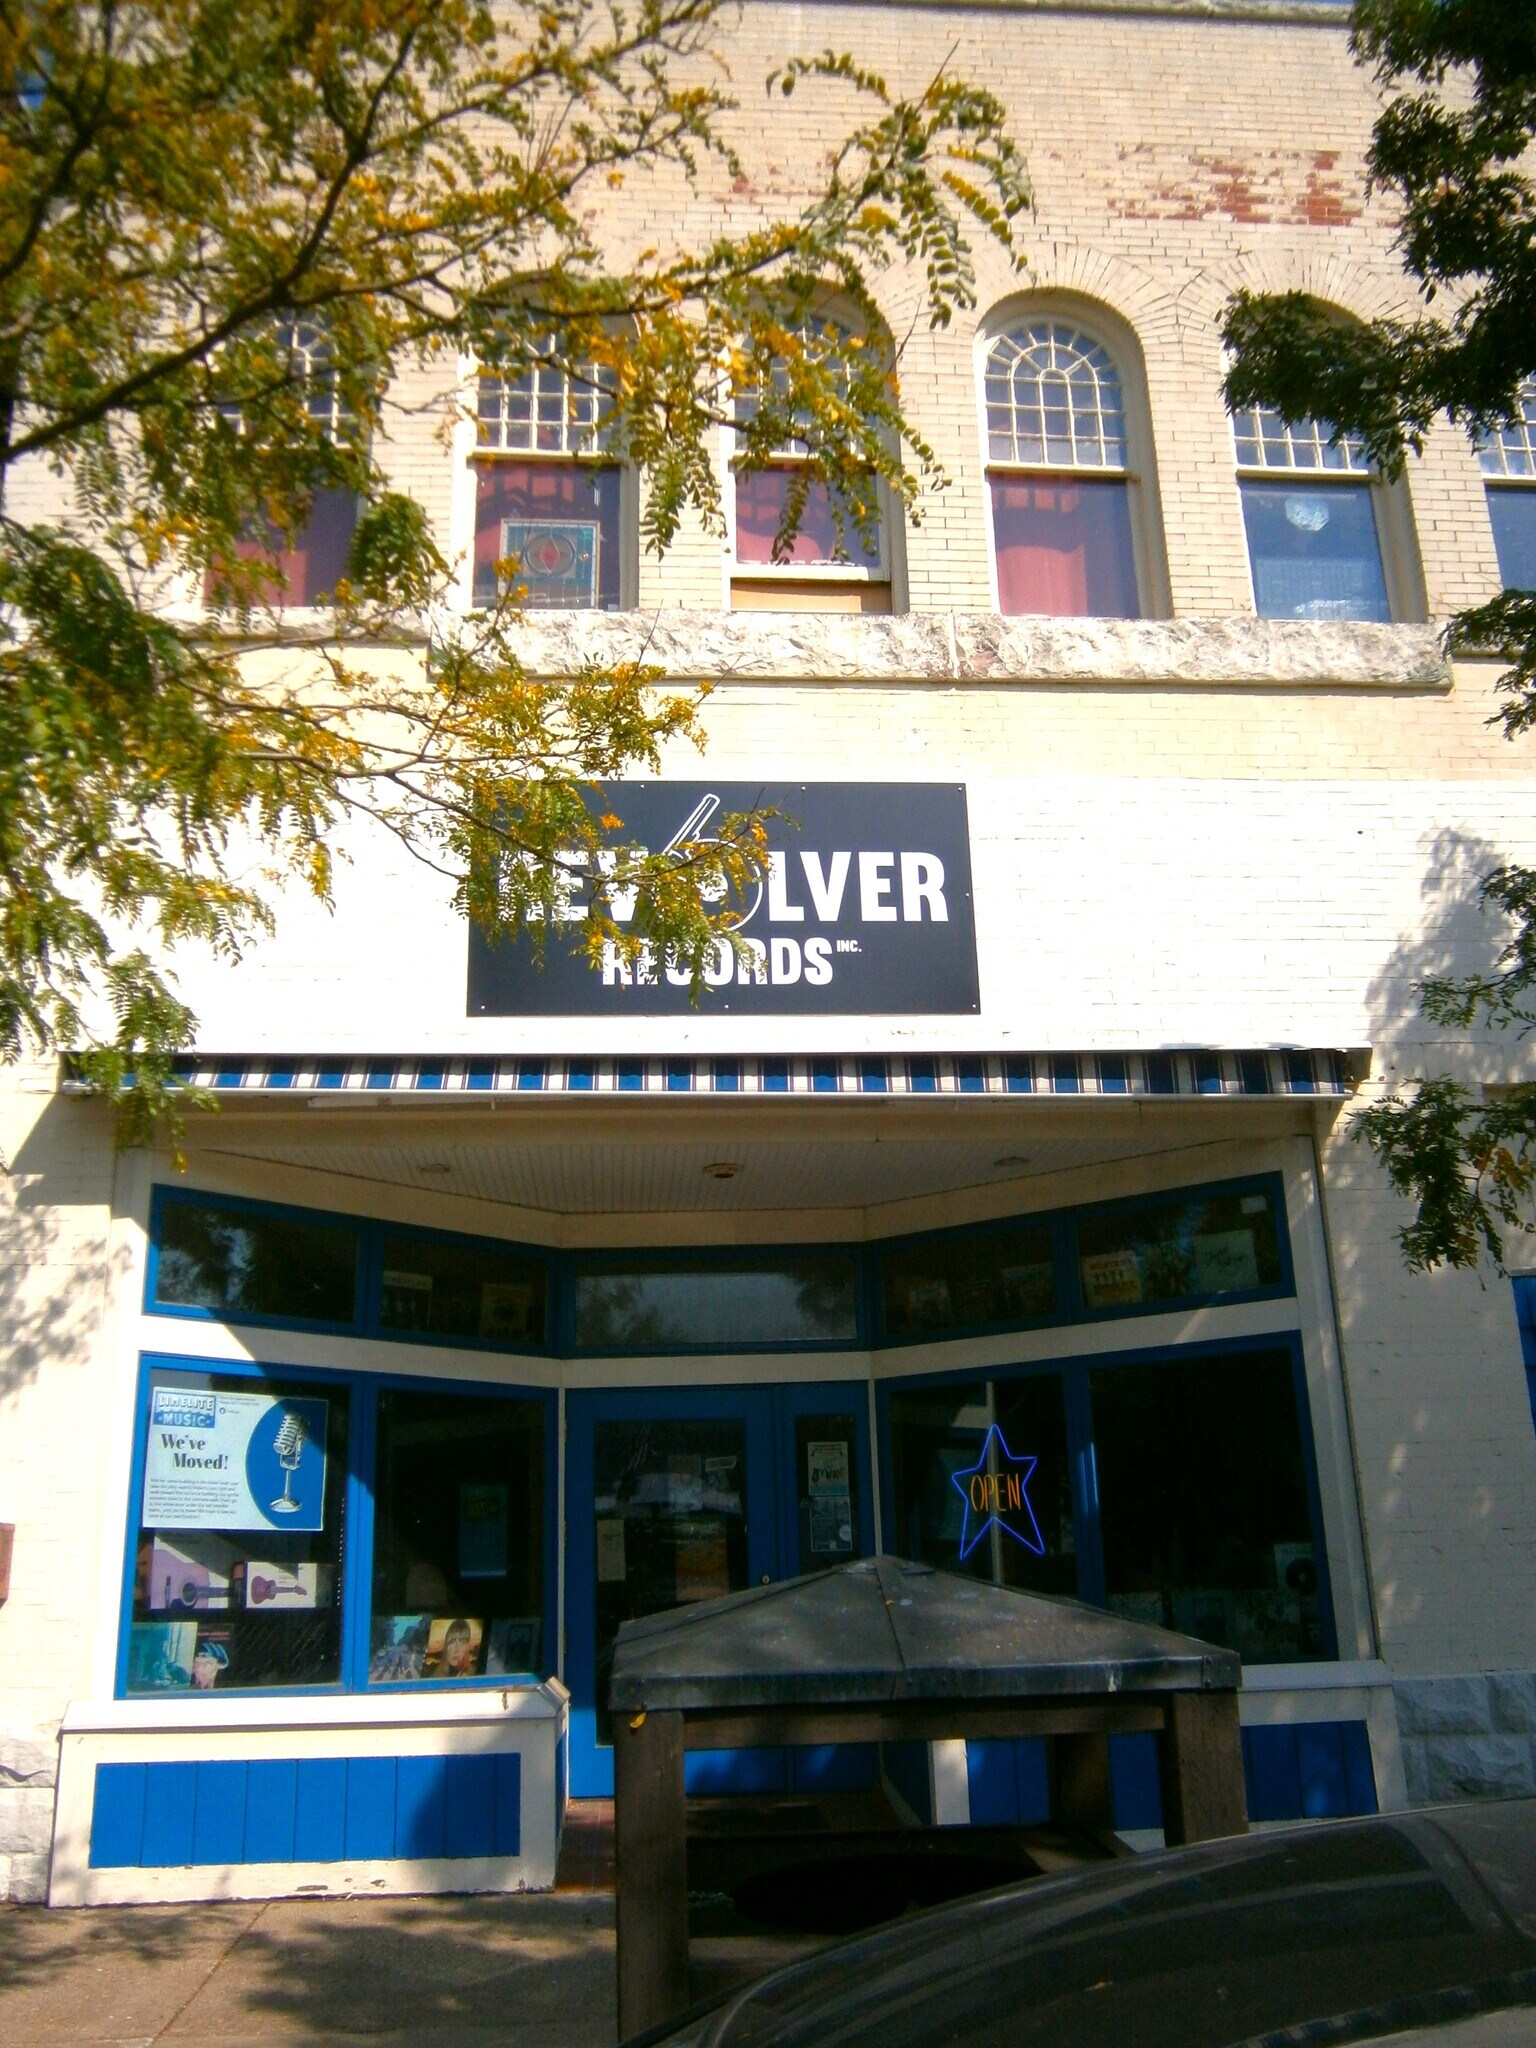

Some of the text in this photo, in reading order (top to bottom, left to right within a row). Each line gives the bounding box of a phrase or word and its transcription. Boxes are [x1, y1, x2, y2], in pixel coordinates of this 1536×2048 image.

[602, 937, 862, 986] RECORDS INC.
[158, 1396, 214, 1411] LIMELITE
[163, 1412, 206, 1426] MUSIC
[160, 1433, 206, 1451] We've
[173, 1452, 229, 1470] Moved!
[970, 1473, 1021, 1511] OPEN
